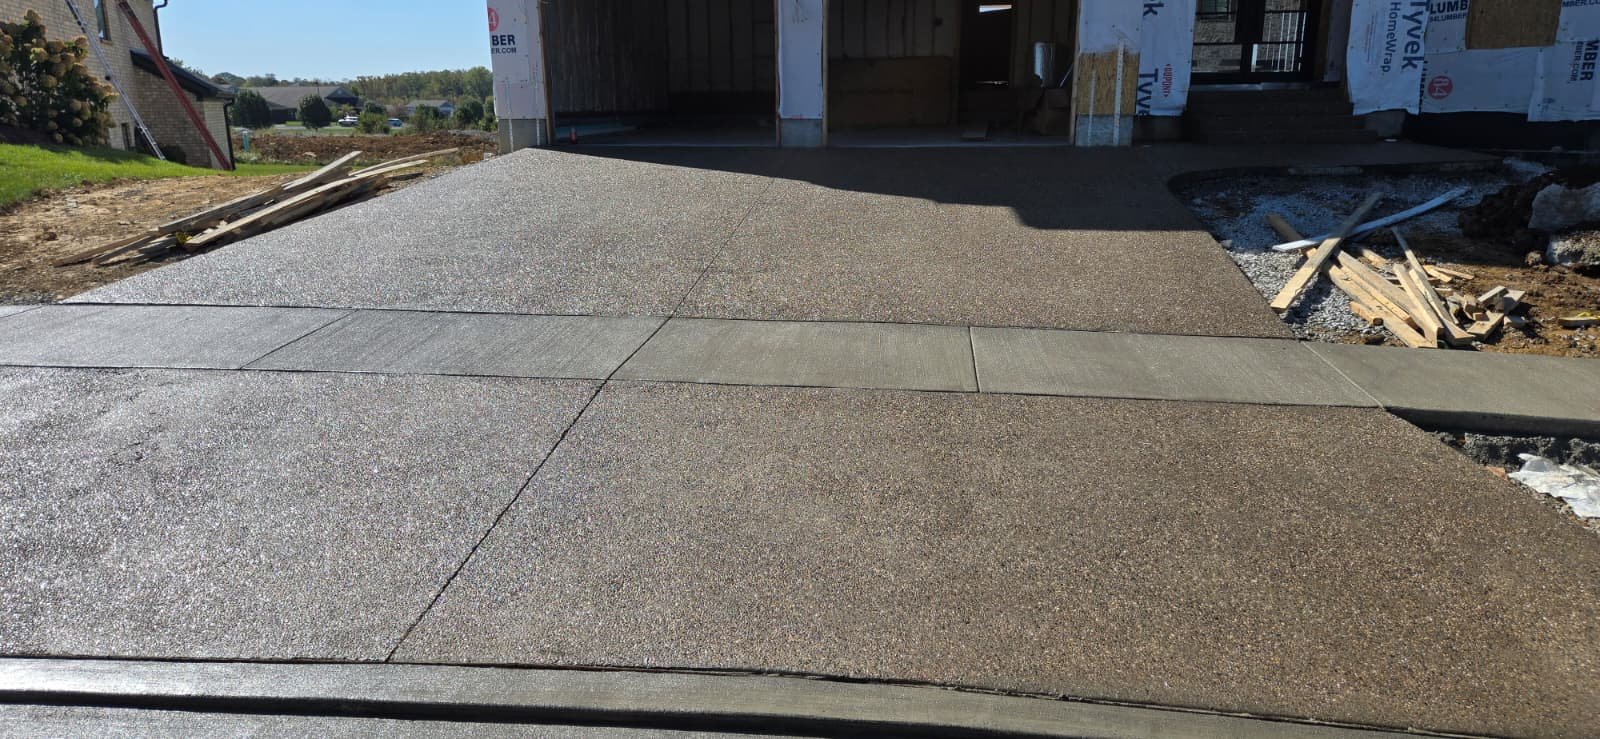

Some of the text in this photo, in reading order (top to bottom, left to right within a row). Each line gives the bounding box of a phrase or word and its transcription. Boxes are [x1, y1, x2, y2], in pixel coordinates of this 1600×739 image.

[491, 34, 516, 46] BER
[1379, 2, 1401, 73] HomeWrap
[1400, 0, 1431, 71] Tyvek
